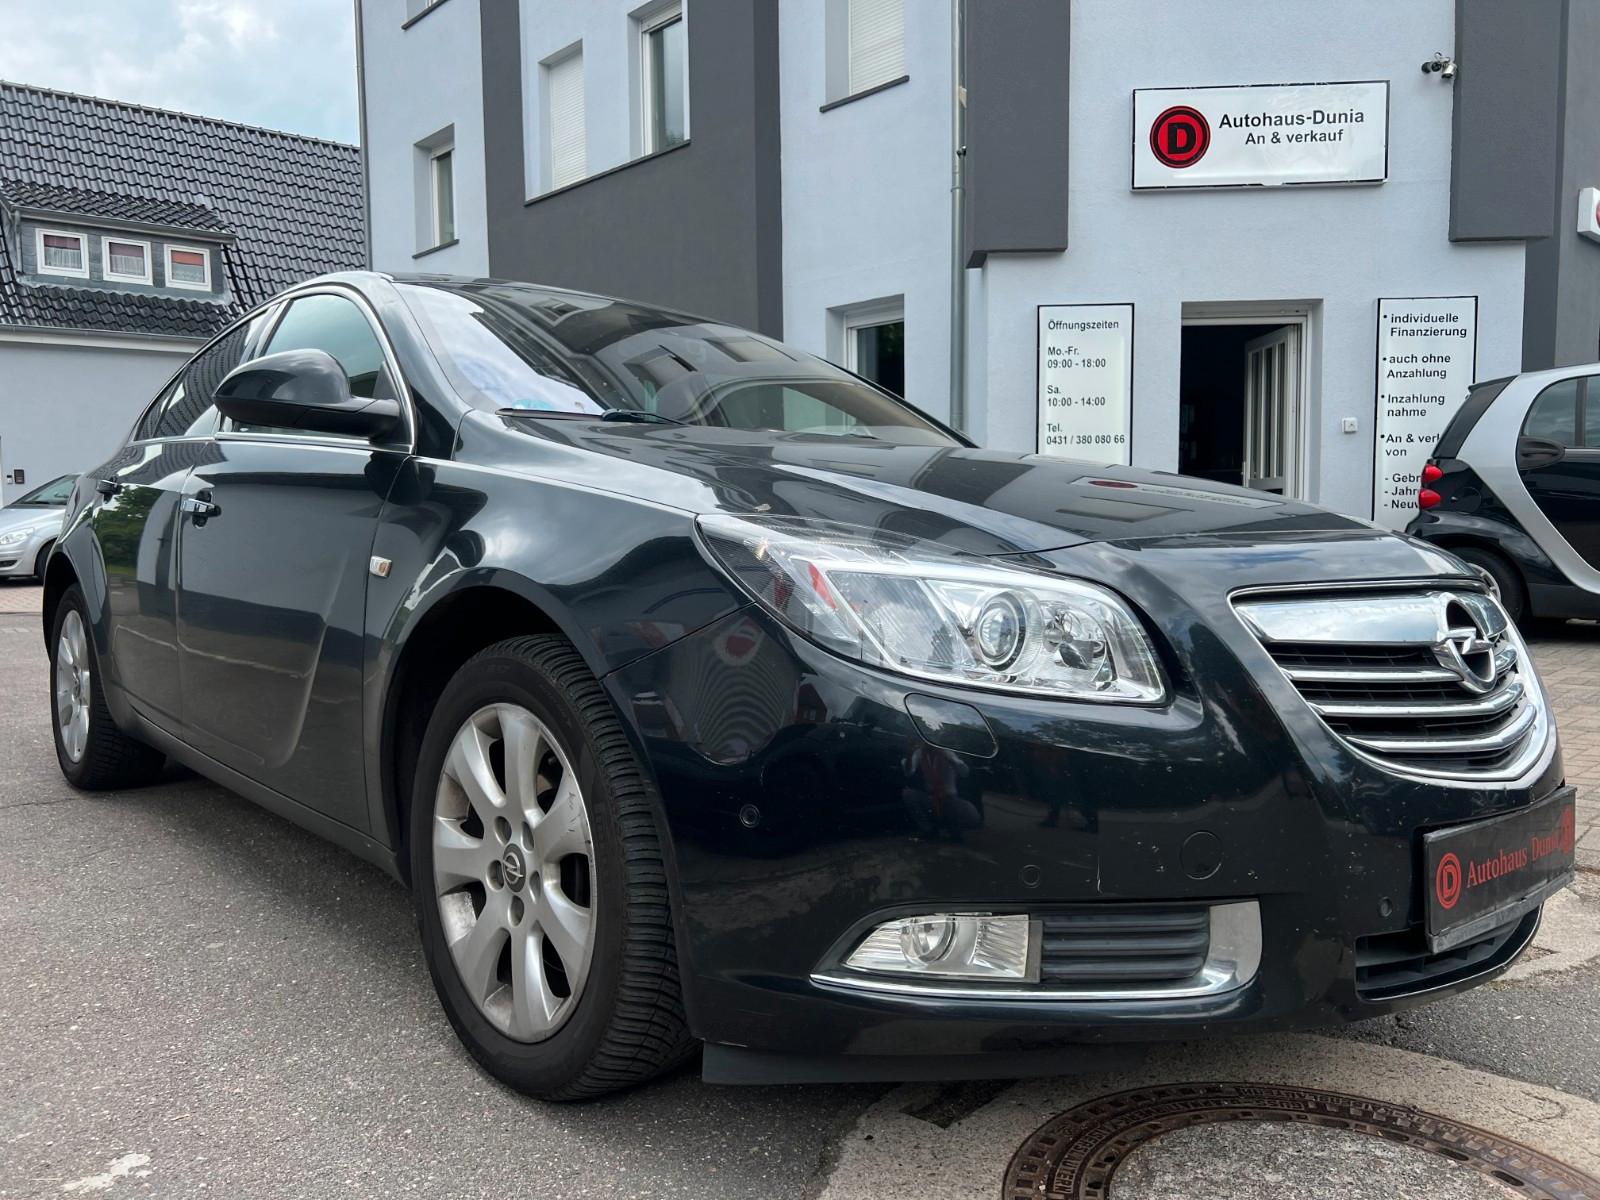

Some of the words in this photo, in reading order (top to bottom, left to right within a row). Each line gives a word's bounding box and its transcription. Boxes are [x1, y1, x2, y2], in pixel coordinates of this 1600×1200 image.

[1218, 109, 1364, 129] Autohaus-Dunia
[1245, 132, 1265, 145] An
[1270, 132, 1281, 144] &
[1286, 129, 1344, 144] verkauf
[1391, 312, 1459, 323] individuelle
[1048, 319, 1119, 332] Öffnungszeiten
[1390, 327, 1467, 338] Finanzierung
[1047, 346, 1080, 356] Mo.-Fr.
[1047, 359, 1073, 368] 09:00
[1082, 358, 1106, 368] 18:00
[1389, 354, 1418, 363] auch
[1421, 354, 1451, 363] ohne
[1387, 369, 1447, 379] Anzahlung
[1047, 385, 1061, 394] Sa.
[1047, 398, 1072, 407] 10:00
[1081, 397, 1106, 406] 14:00
[1387, 394, 1445, 405] Inzahlung
[1387, 408, 1427, 417] nahme
[1046, 423, 1063, 432] Tel.
[1046, 436, 1068, 445] 0431
[1076, 435, 1092, 444] 380
[1095, 434, 1111, 444] 080
[1114, 434, 1125, 444] 66
[1385, 434, 1402, 443] An
[1406, 433, 1415, 443] &
[1385, 448, 1407, 456] von
[1466, 847, 1528, 888] Autohaus
